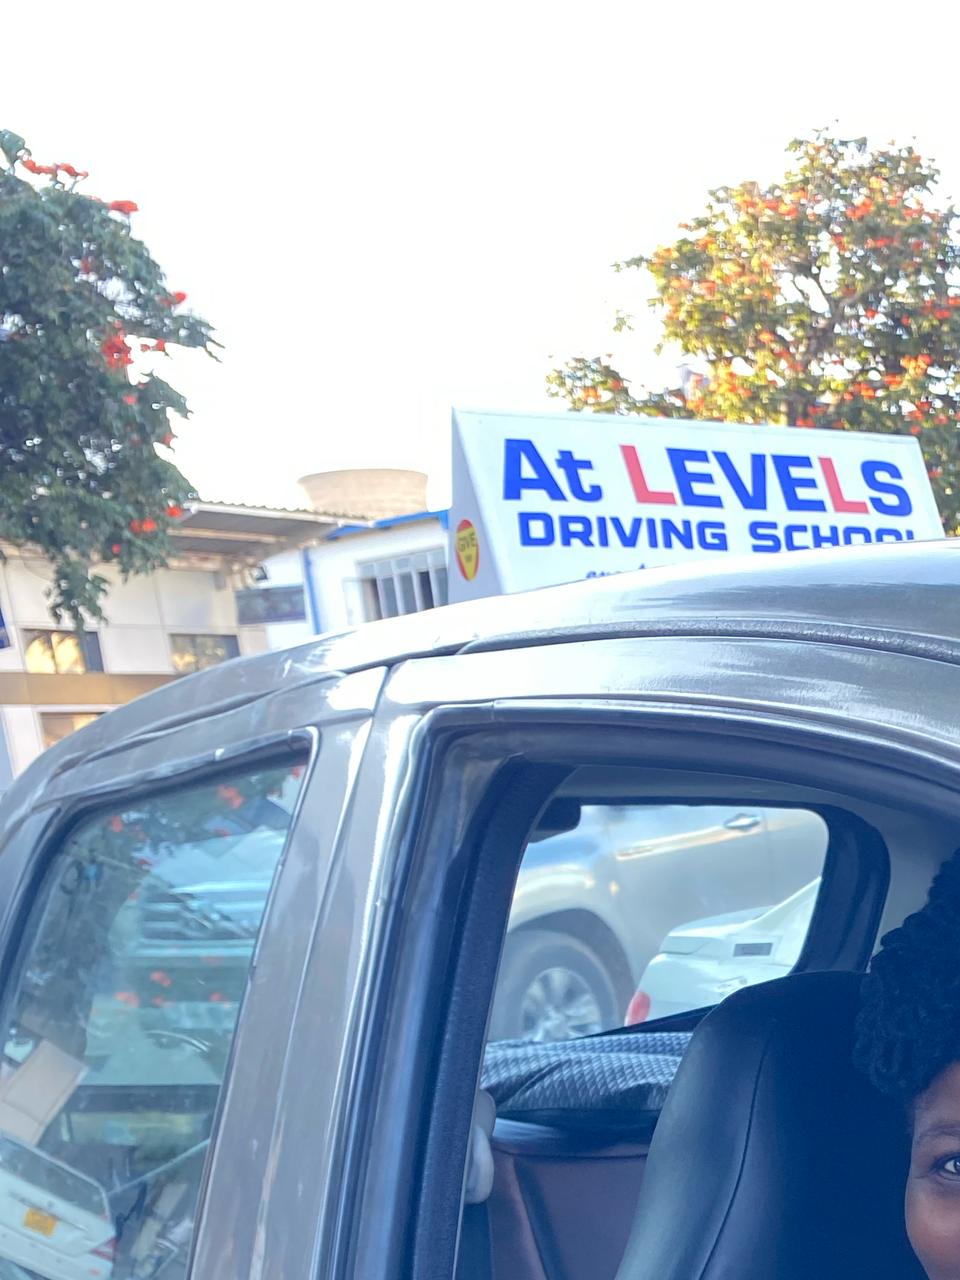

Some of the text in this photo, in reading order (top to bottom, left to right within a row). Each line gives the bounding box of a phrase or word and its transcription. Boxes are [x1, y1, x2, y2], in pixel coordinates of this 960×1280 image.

[503, 438, 914, 517] At LEVELS
[517, 512, 728, 552] DRIVING
